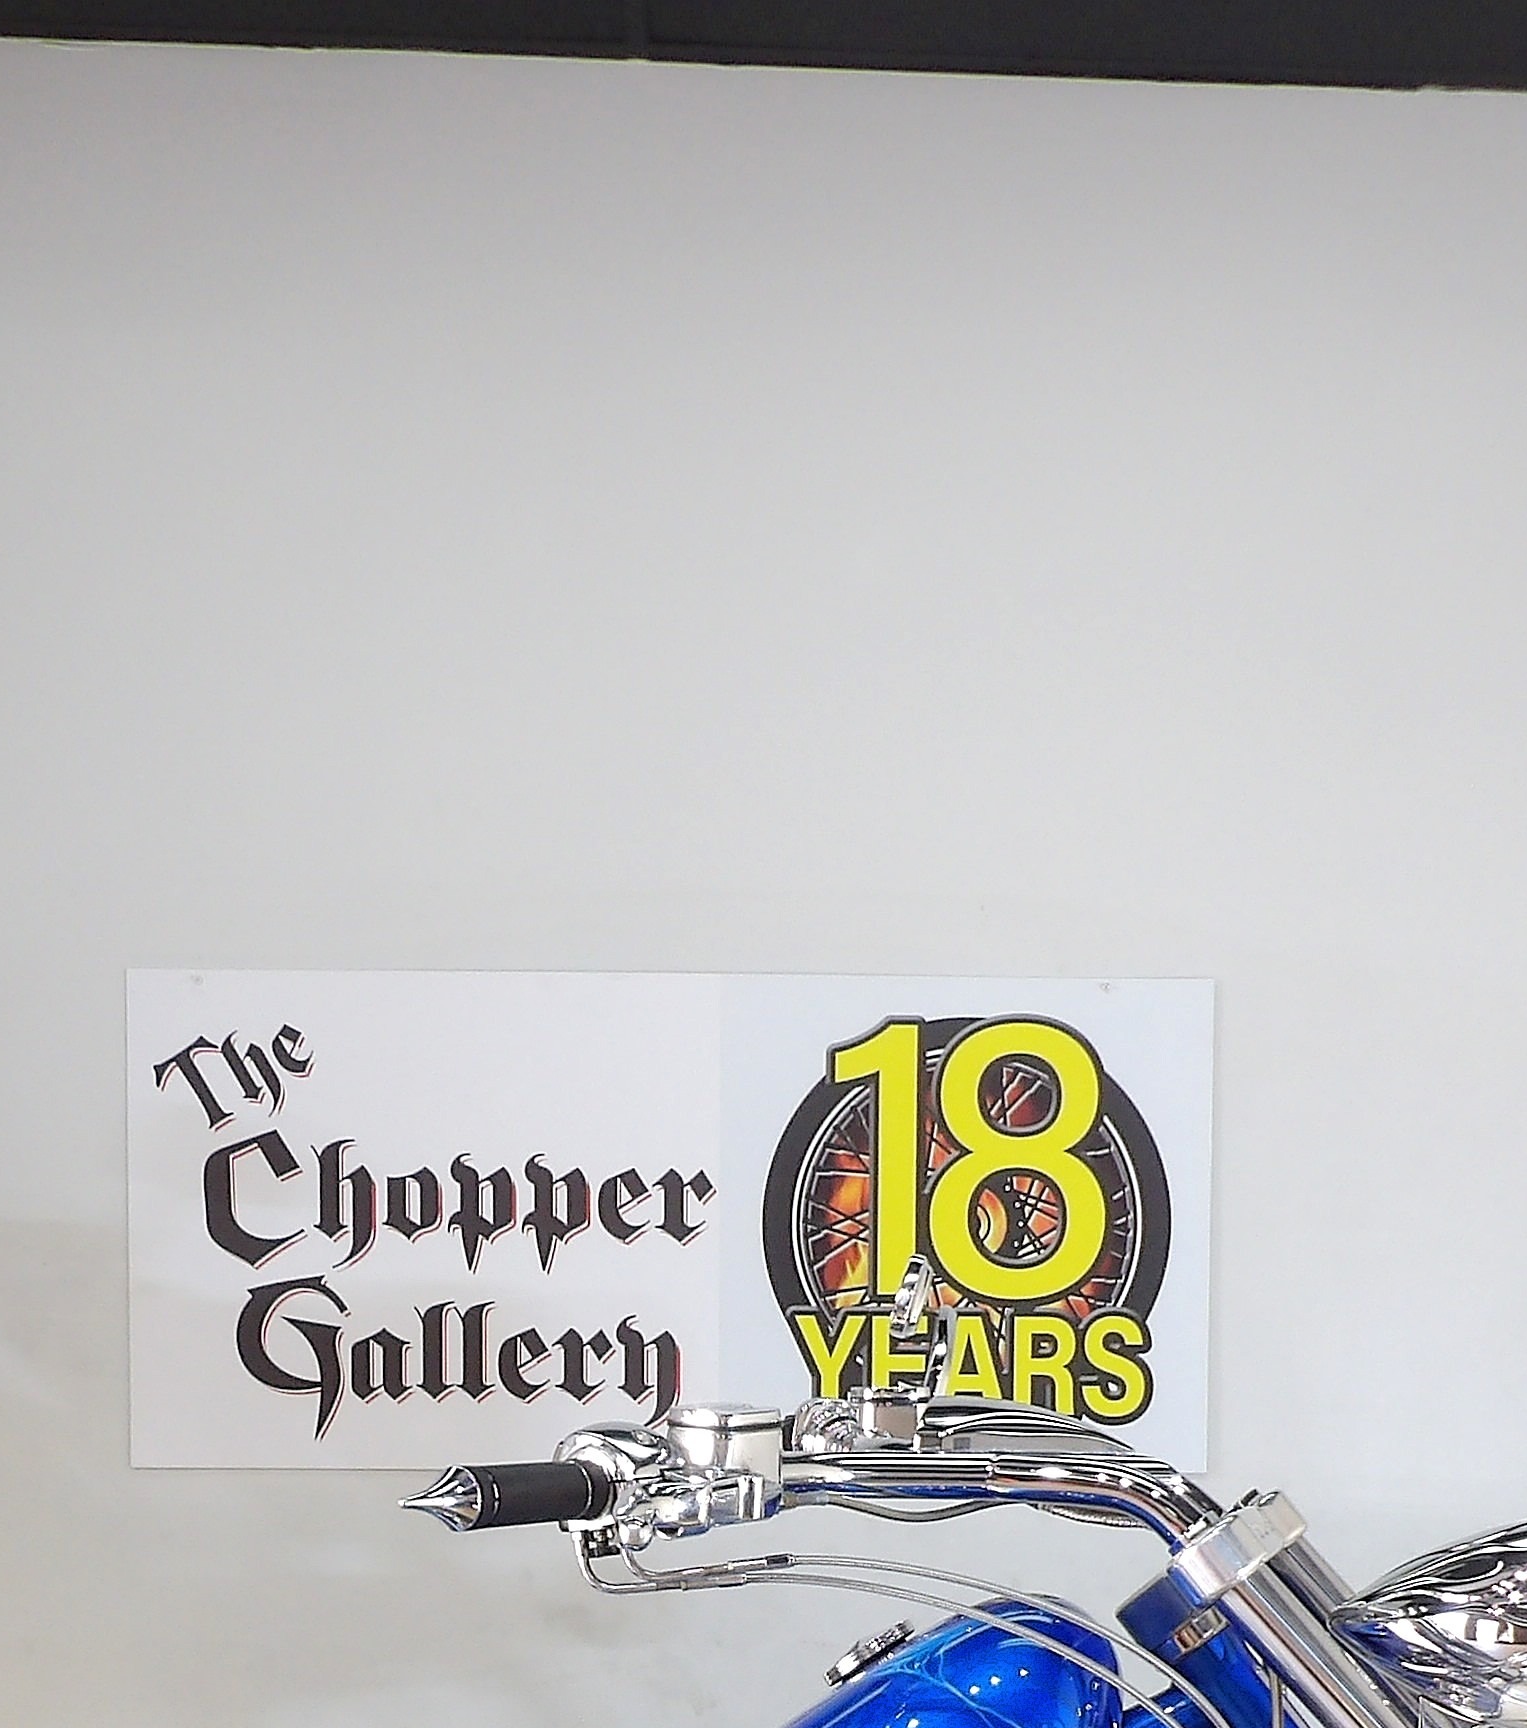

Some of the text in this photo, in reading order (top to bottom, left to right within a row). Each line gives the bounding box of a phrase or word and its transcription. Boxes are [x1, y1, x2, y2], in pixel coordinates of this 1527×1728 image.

[153, 1022, 315, 1132] The
[203, 1129, 717, 1275] Chopper
[829, 1016, 1110, 1303] 18
[235, 1274, 682, 1442] Gallery
[792, 1310, 1149, 1420] YEARS
